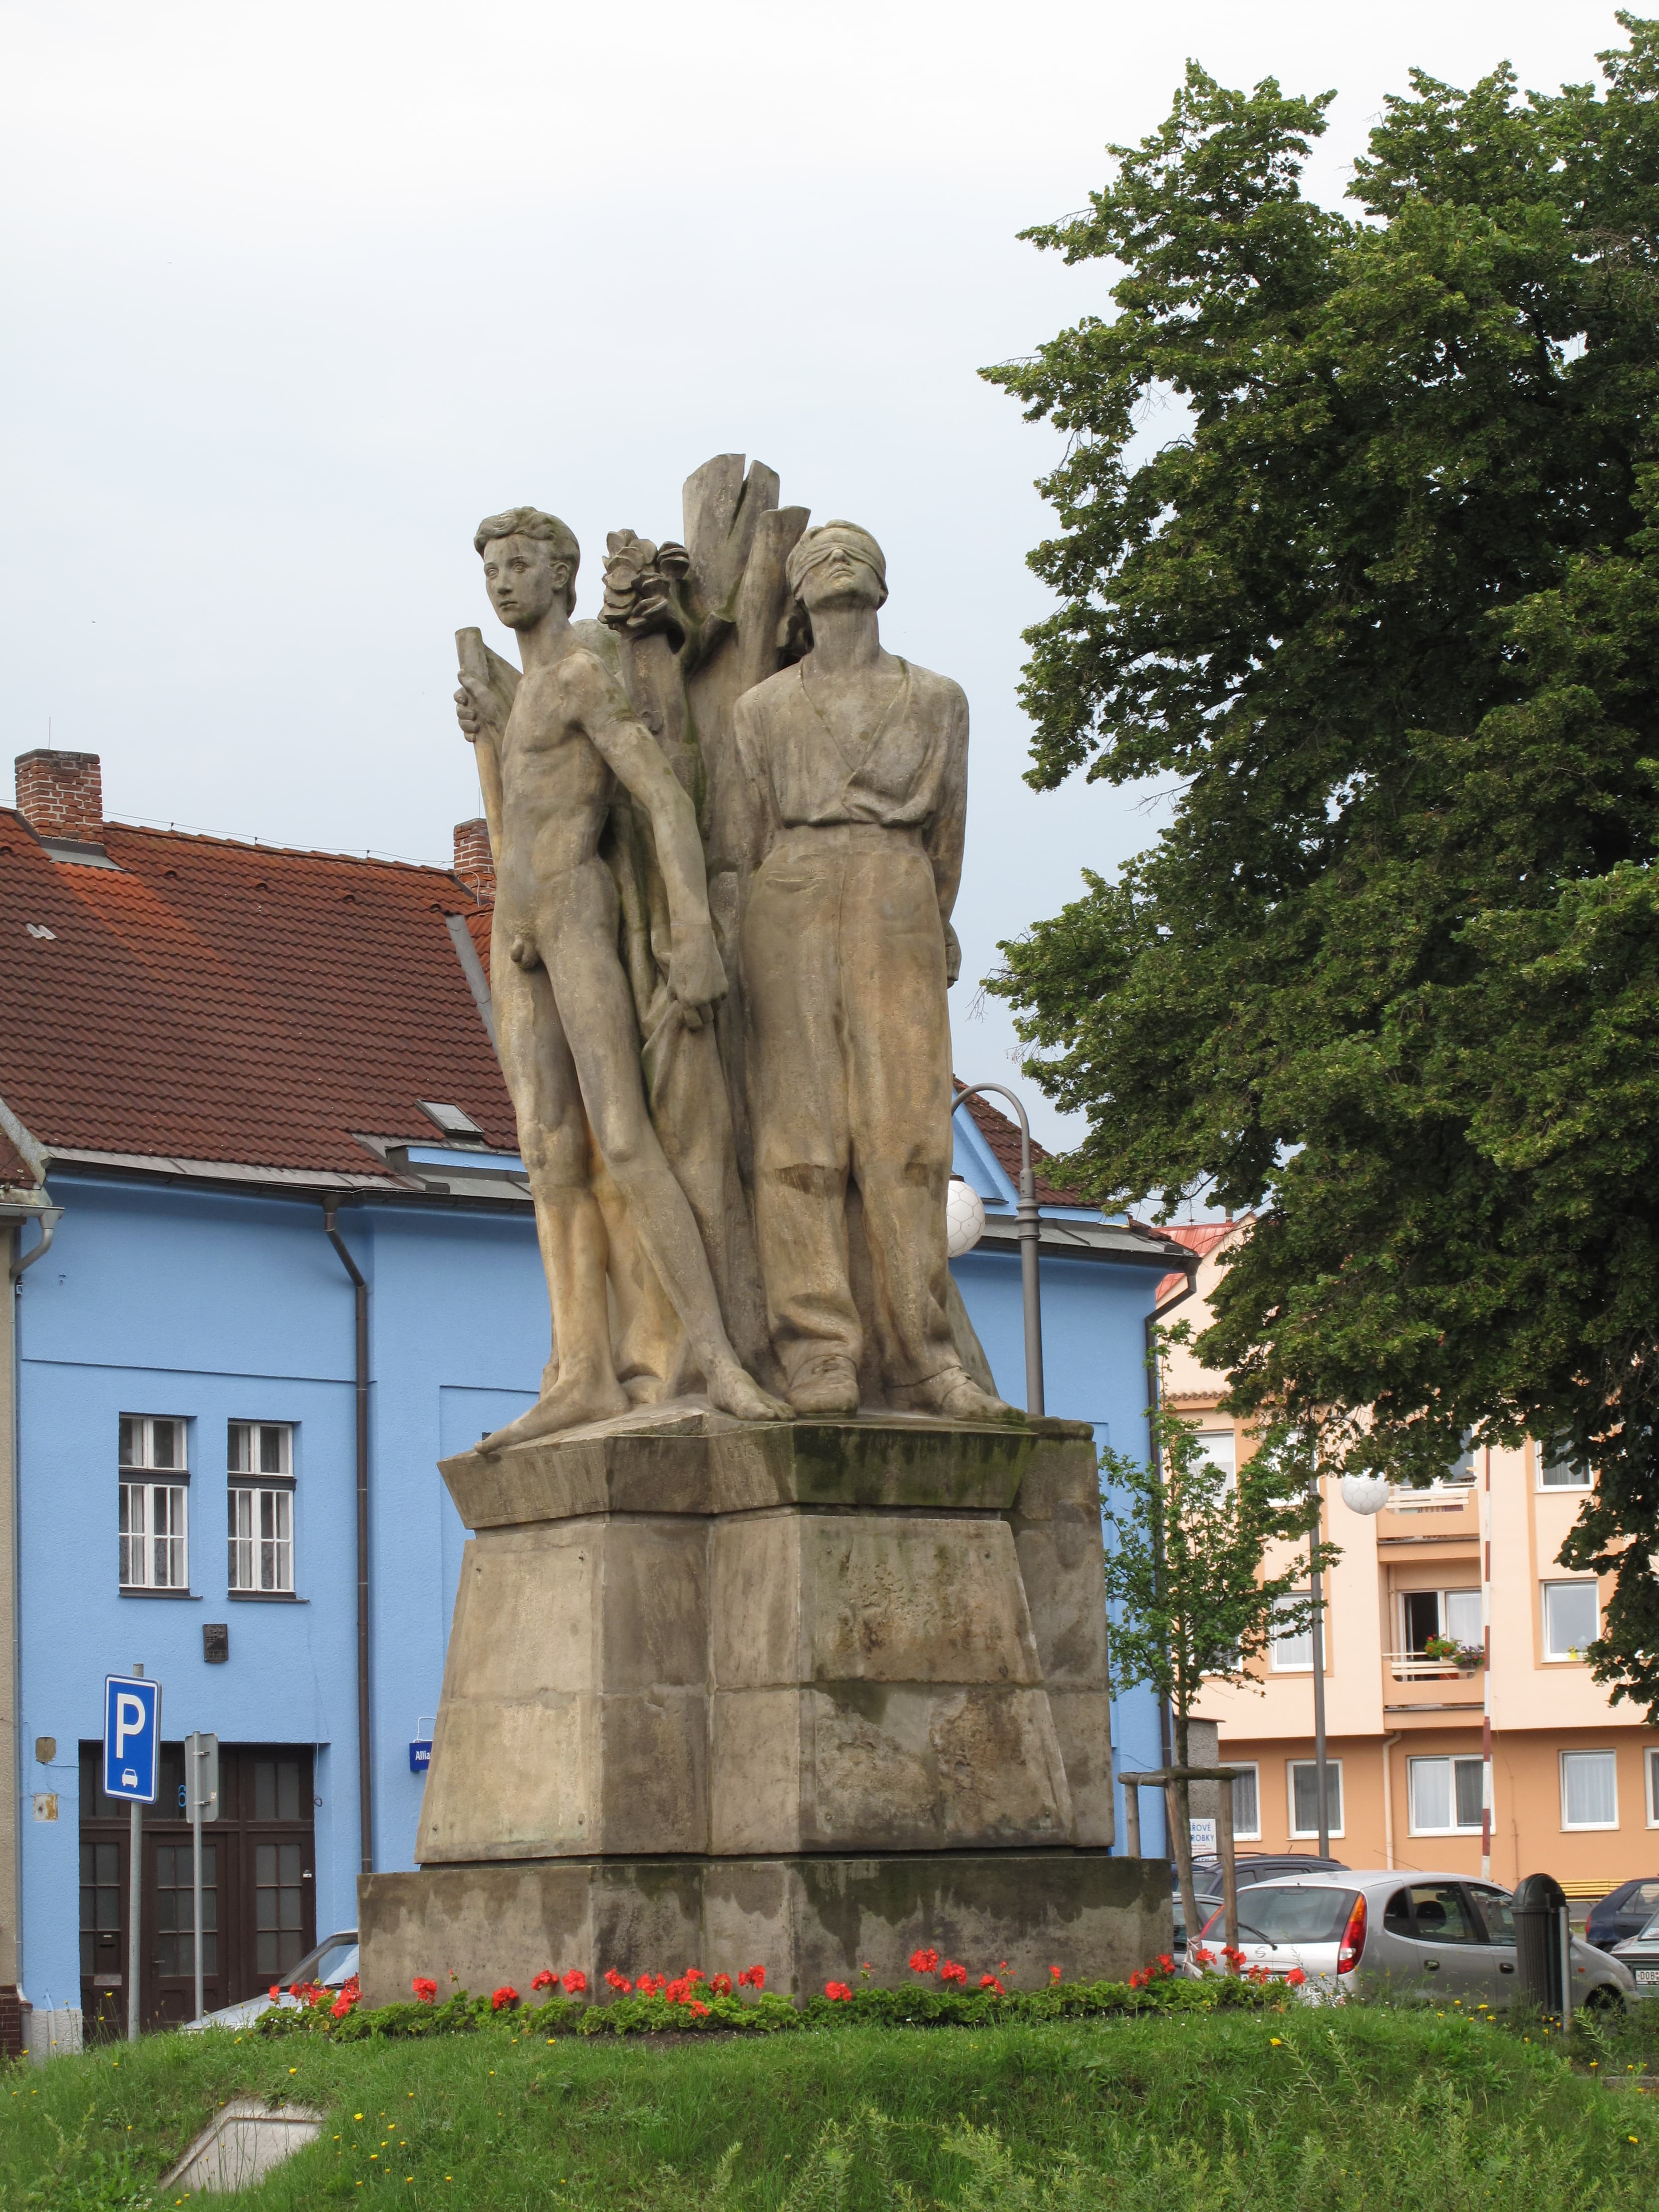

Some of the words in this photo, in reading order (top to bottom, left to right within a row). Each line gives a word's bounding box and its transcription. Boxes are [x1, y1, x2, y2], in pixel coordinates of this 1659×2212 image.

[116, 1693, 145, 1758] P
[415, 1751, 430, 1760] Allia
[178, 1784, 186, 1807] 6
[1190, 1822, 1211, 1831] ŘOVÉ
